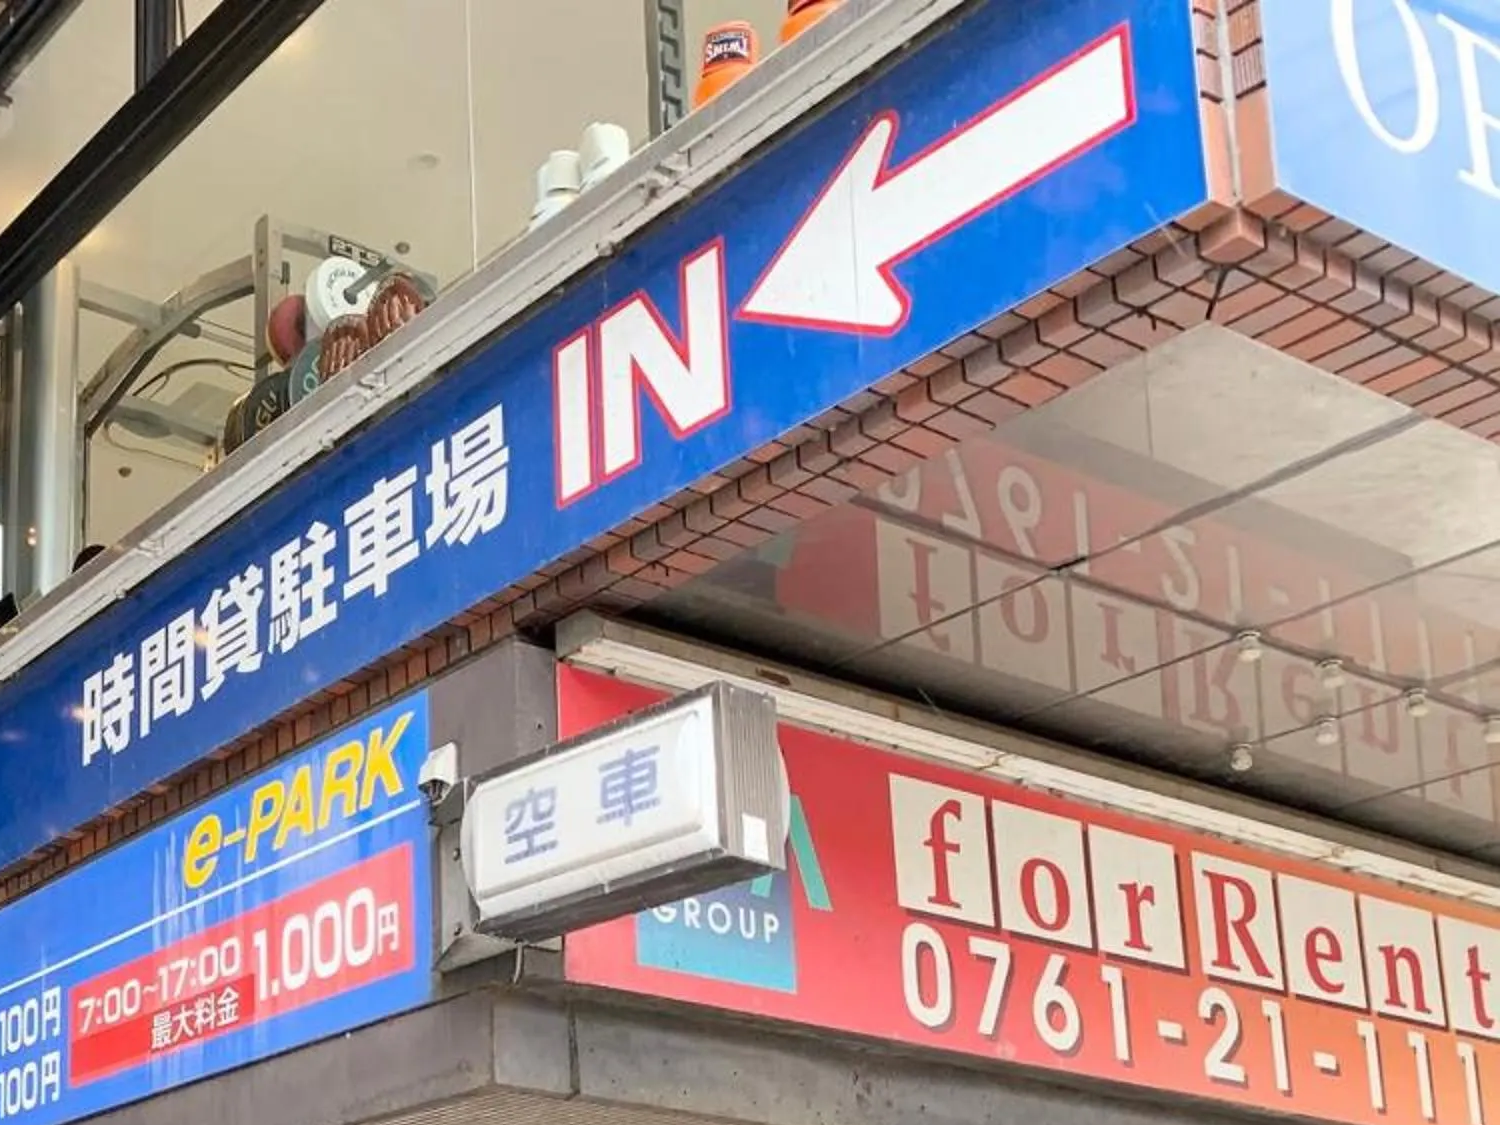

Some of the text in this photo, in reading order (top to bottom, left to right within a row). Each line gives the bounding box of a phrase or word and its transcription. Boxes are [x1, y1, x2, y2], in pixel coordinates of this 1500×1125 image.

[553, 237, 731, 508] IN
[80, 404, 510, 766] 時間貸駐車場
[181, 711, 415, 889] e-PARK
[652, 898, 780, 944] GROUP
[151, 986, 240, 1051] 最大料金
